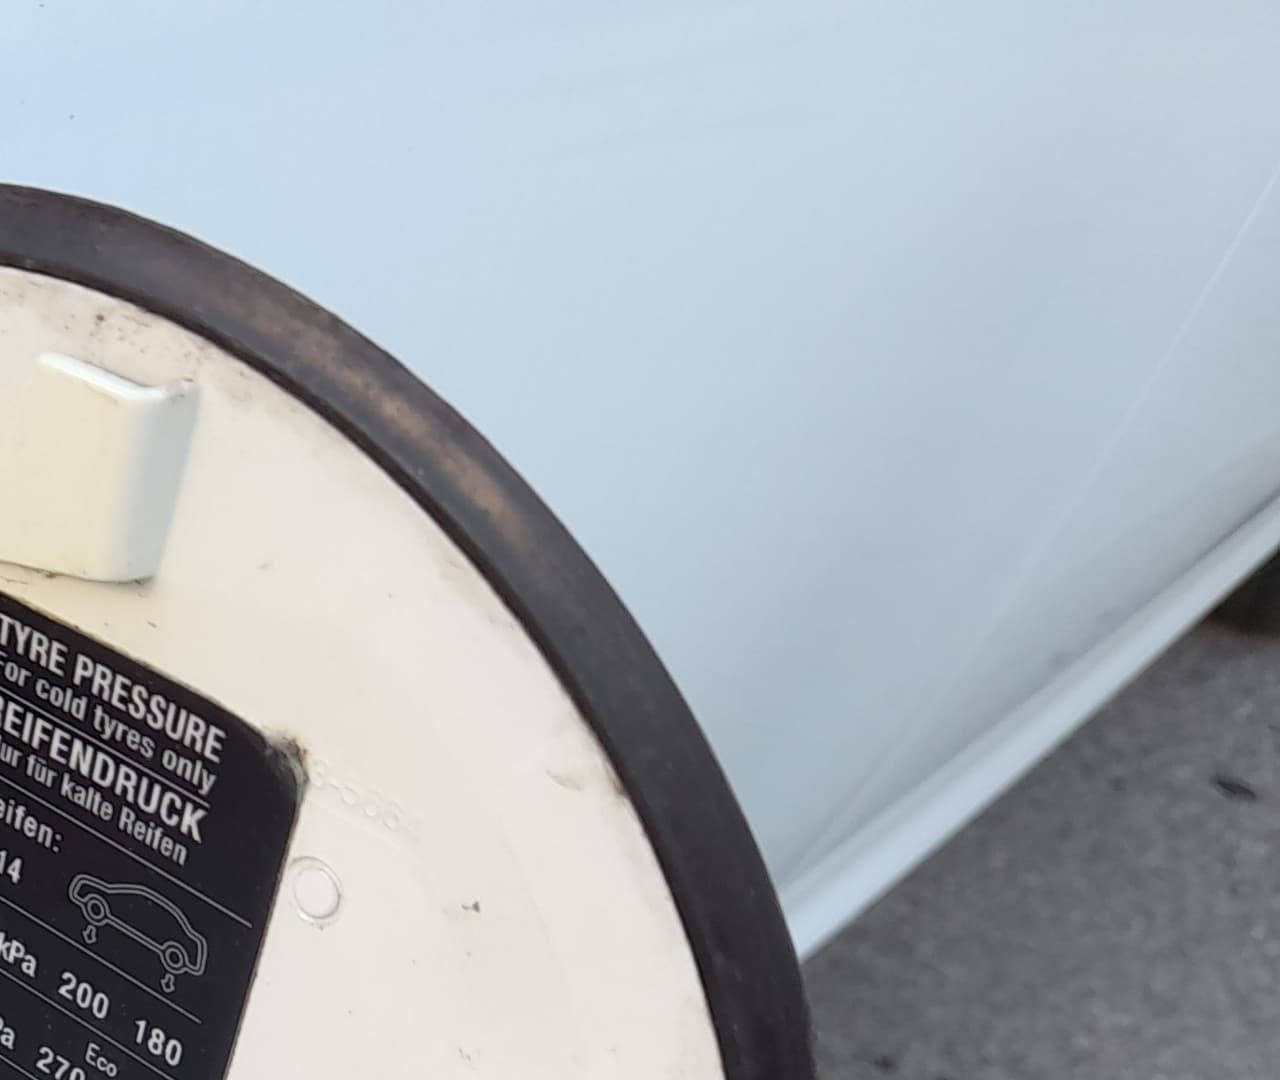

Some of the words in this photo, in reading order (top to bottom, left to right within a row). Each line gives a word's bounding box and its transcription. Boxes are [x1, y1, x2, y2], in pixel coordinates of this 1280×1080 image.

[35, 679, 87, 720] cold
[94, 705, 154, 758] tyres
[162, 750, 216, 795] only
[73, 654, 226, 763] PRESSURE
[26, 754, 58, 787] für
[61, 773, 113, 820] kalte
[119, 806, 187, 865] Reifen
[58, 972, 109, 1019] 200
[135, 1020, 182, 1066] 180
[85, 1043, 117, 1077] Eco
